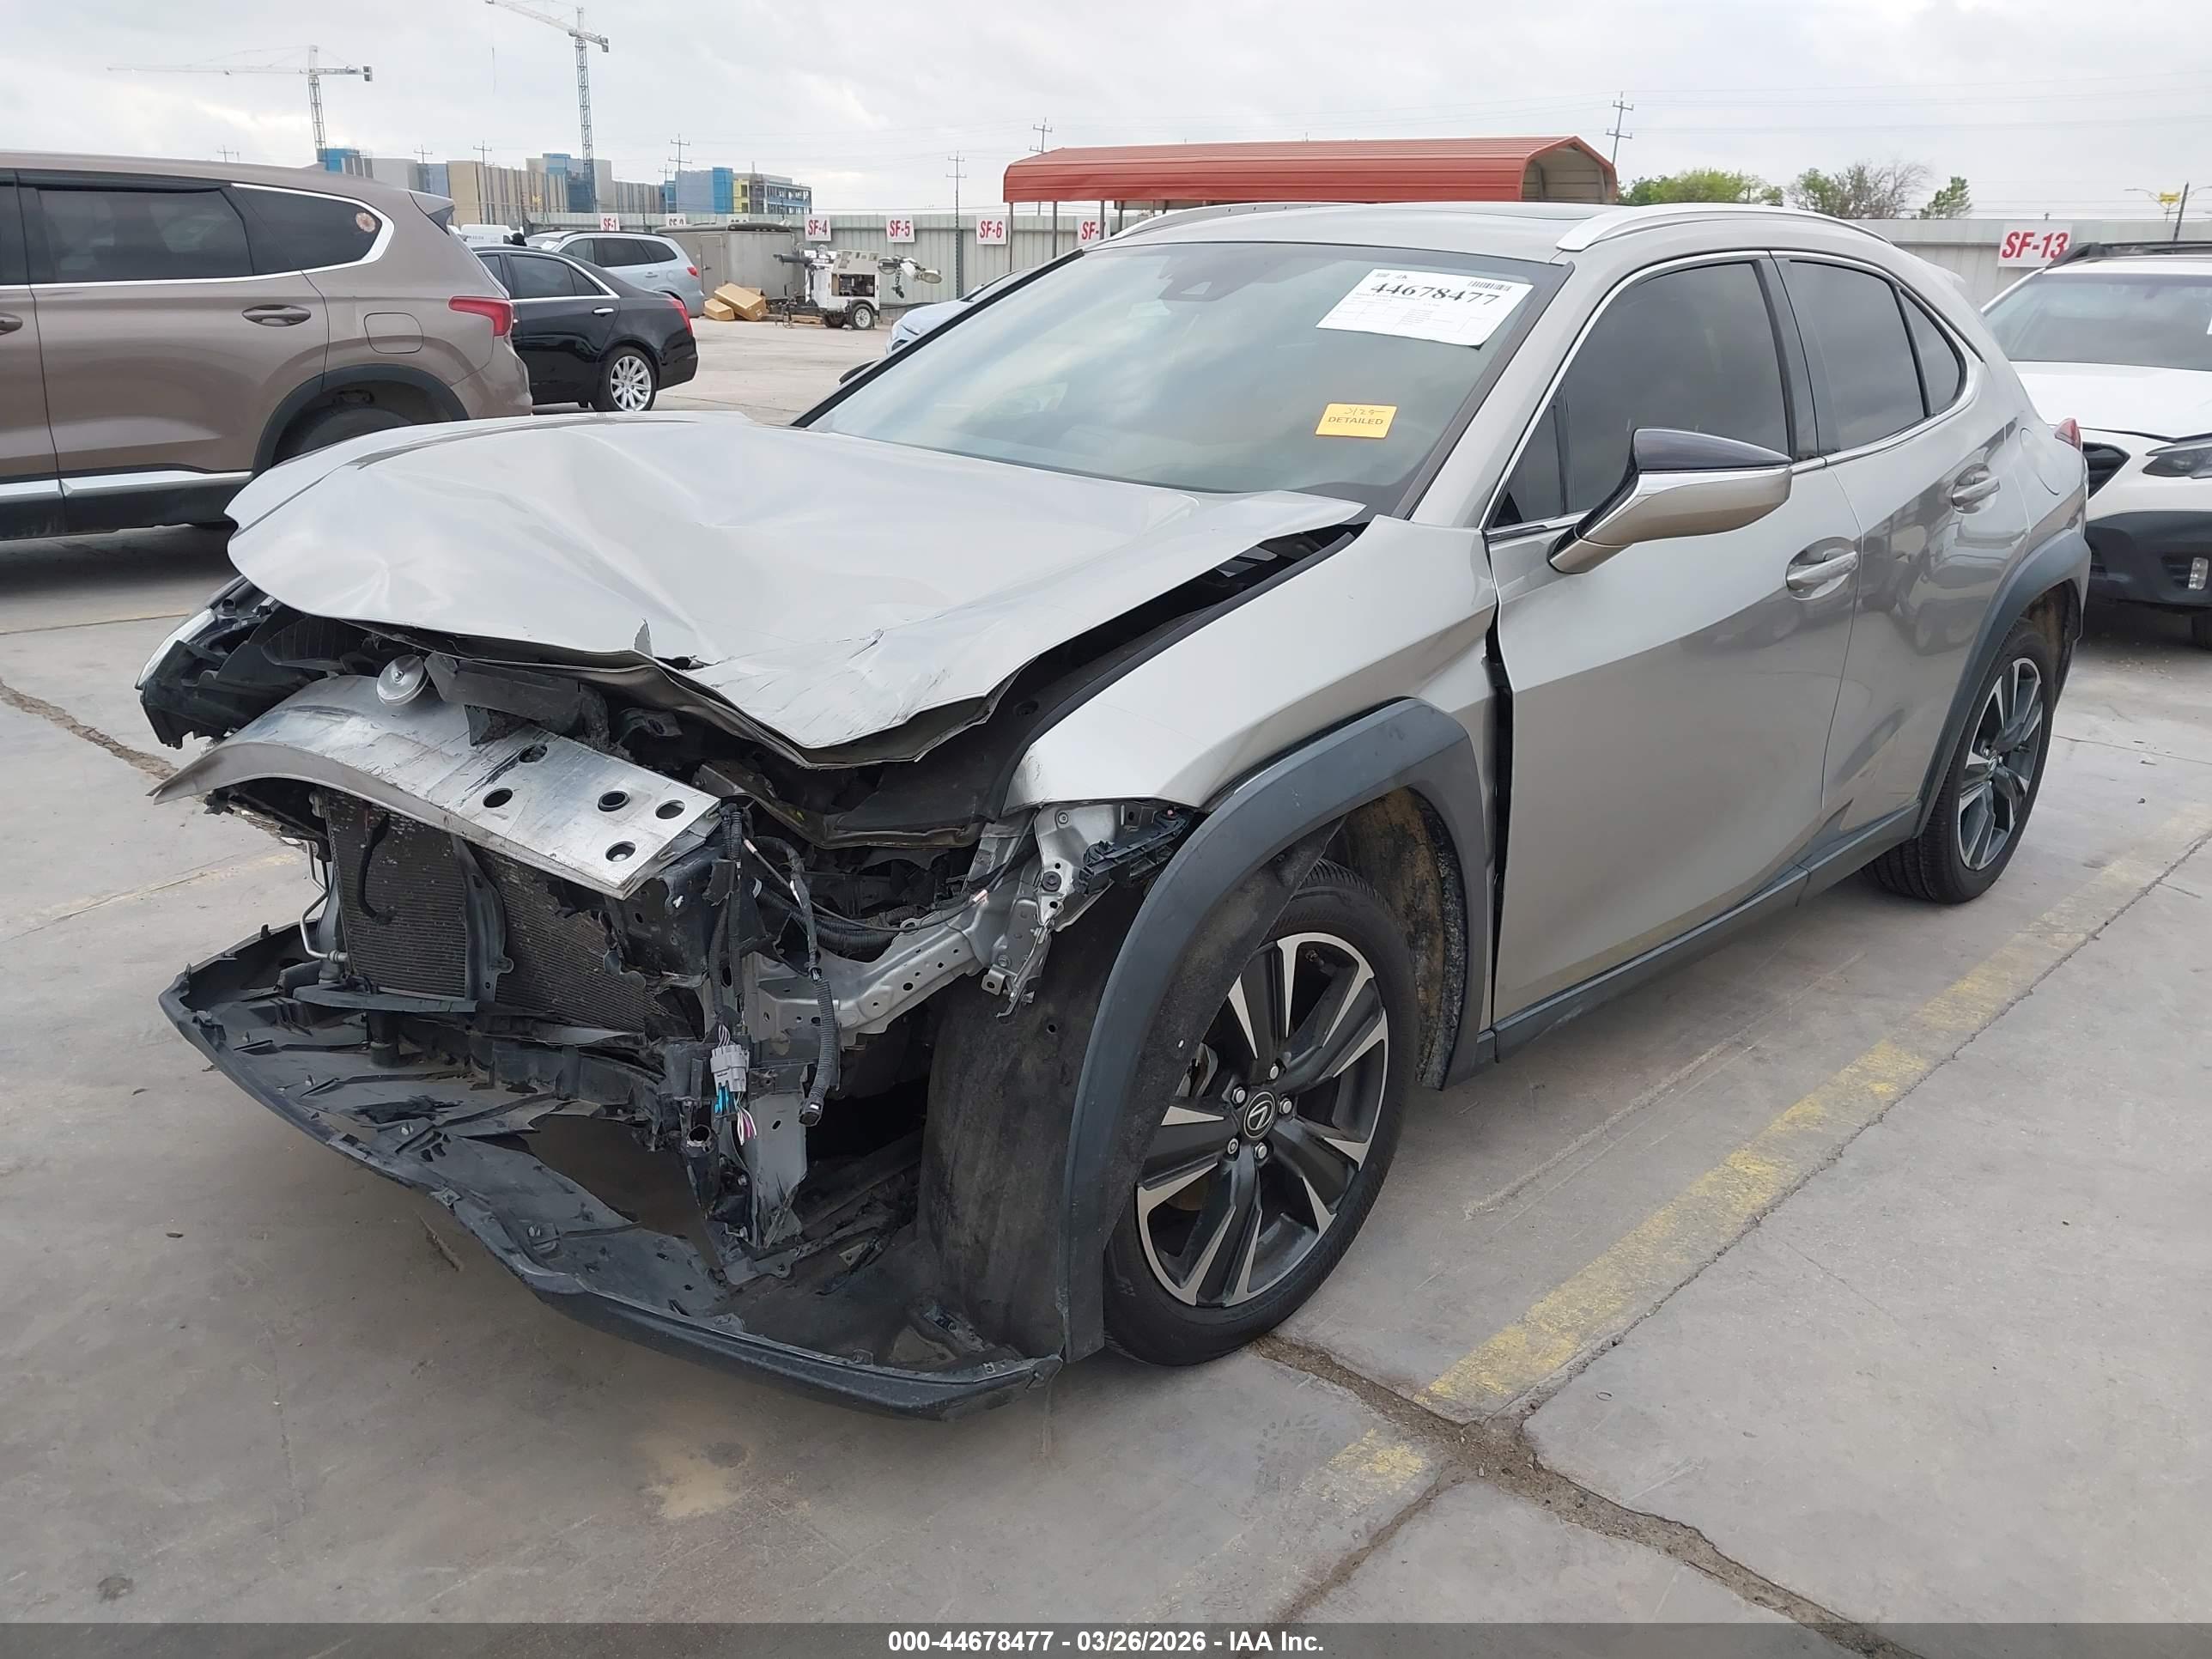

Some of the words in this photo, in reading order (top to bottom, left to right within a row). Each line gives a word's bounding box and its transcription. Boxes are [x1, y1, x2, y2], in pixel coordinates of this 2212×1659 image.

[807, 219, 828, 235] SF-4
[889, 220, 910, 237] SF-5
[979, 220, 1003, 239] SF-6
[2001, 231, 2069, 259] SF-13
[1370, 282, 1501, 306] 44678477
[1328, 416, 1384, 425] DETAILED
